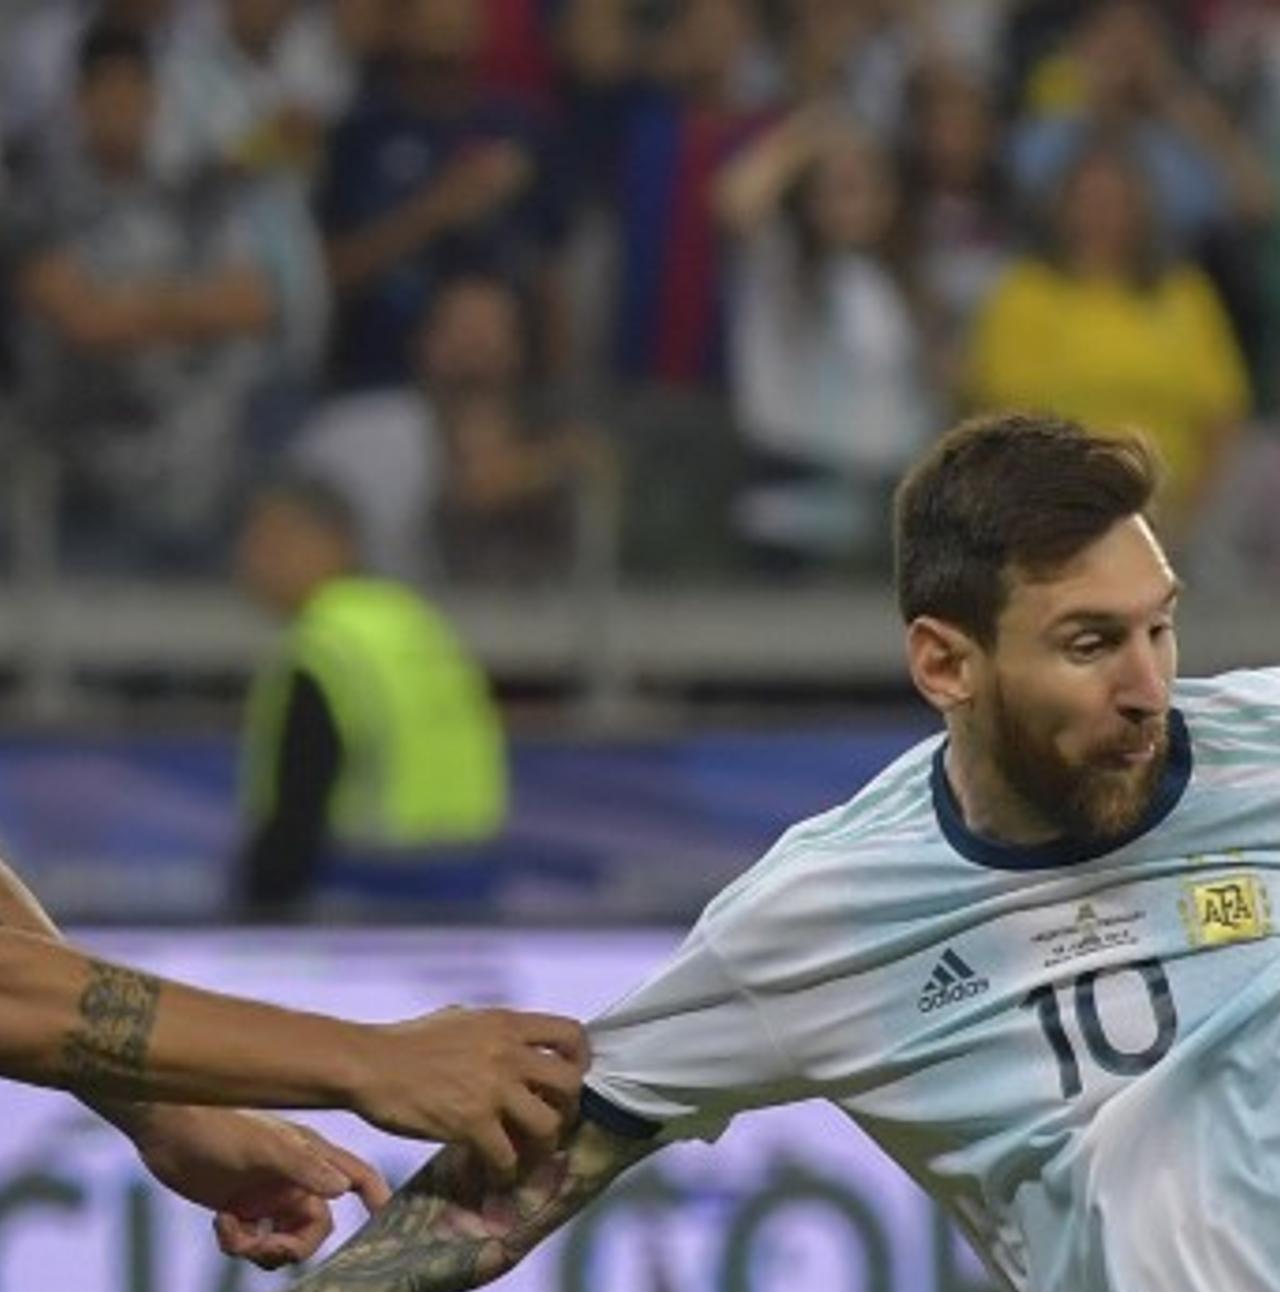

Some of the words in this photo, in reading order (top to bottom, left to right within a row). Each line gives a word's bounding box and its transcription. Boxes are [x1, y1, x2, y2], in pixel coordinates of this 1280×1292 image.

[1202, 884, 1252, 927] AFA
[918, 978, 989, 1013] adidas
[1020, 957, 1178, 1099] 10
